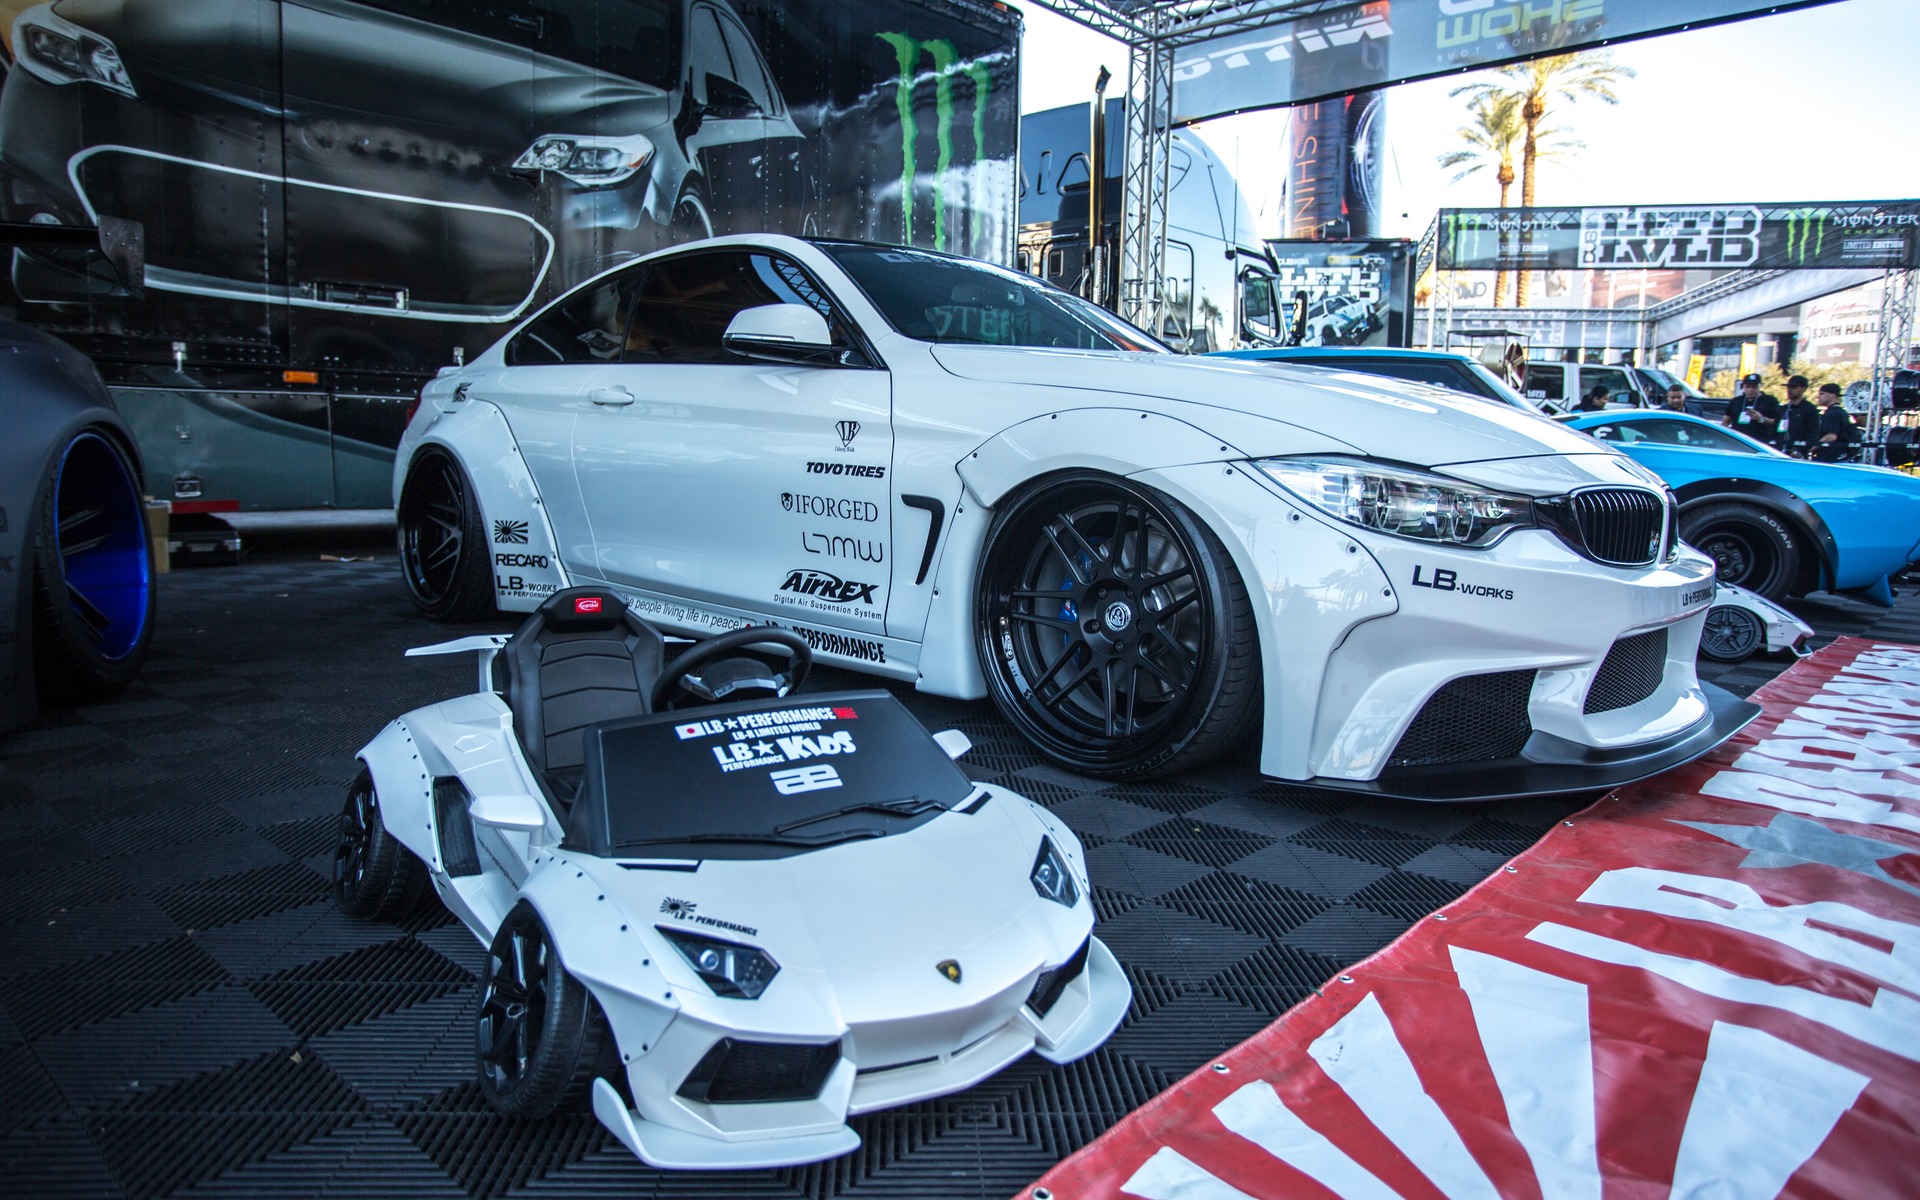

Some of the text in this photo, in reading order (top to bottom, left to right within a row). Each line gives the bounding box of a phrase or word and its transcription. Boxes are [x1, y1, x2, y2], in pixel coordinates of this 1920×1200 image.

[1294, 136, 1318, 239] SHINE
[1486, 220, 1561, 232] MONSTER
[1832, 213, 1920, 227] MONSTER
[1812, 325, 1841, 339] SOUTH
[1845, 322, 1879, 335] HALL
[806, 462, 886, 479] TOYO TIRES
[794, 494, 879, 522] IFORGED
[1760, 515, 1793, 549] ADVAN
[495, 553, 549, 569] RECARO
[513, 591, 553, 599] PERFORMAN
[634, 600, 662, 615] people
[663, 603, 685, 622] living
[685, 607, 699, 622] life
[700, 611, 709, 624] in
[710, 615, 740, 630] peace
[774, 593, 882, 620] Digital Air Suspension System
[737, 707, 837, 730] PERFORMANCE
[754, 725, 791, 739] LIMITED
[790, 722, 822, 734] WORLD
[721, 754, 786, 773] PERFORMANCE
[696, 915, 758, 936] PERFORMANCE
